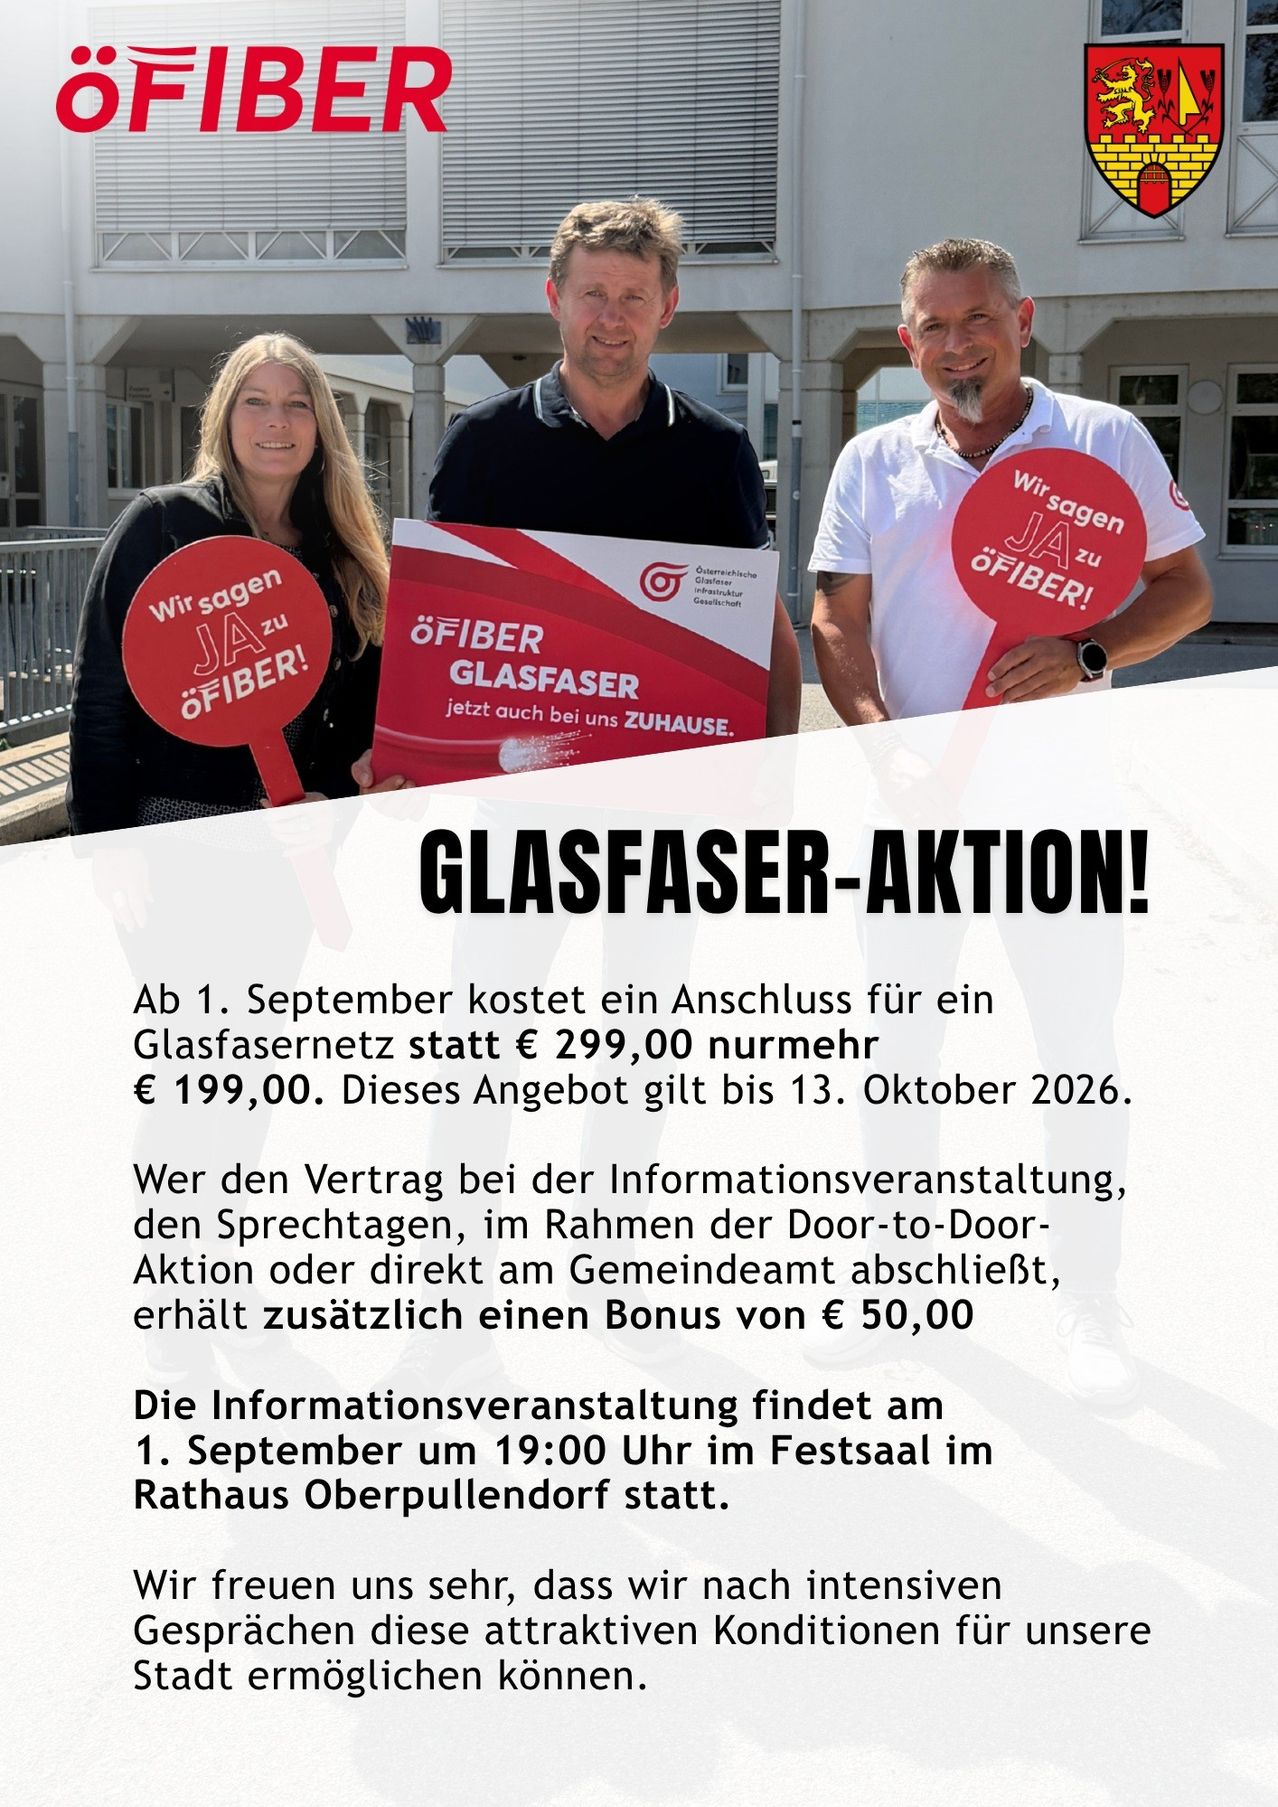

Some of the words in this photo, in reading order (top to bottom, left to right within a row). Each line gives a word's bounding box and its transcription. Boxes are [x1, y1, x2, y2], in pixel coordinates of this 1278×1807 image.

[1013, 469, 1050, 498] Wir
[1046, 494, 1125, 535] sagen
[1004, 511, 1070, 570] JA
[1075, 548, 1102, 568] zu
[695, 565, 758, 579] Österreichische
[695, 576, 732, 586] Glasfaser
[149, 594, 193, 623] Wir
[198, 569, 282, 615] sagen
[693, 597, 742, 608] Gesellschaft
[193, 612, 266, 676] JA
[261, 613, 289, 636] zu
[449, 659, 640, 700] GLASFASER
[445, 698, 490, 718] jetzt
[495, 704, 543, 722] auch
[549, 704, 580, 724] bei
[585, 712, 618, 728] uns
[624, 711, 735, 737] ZUHAUSE.
